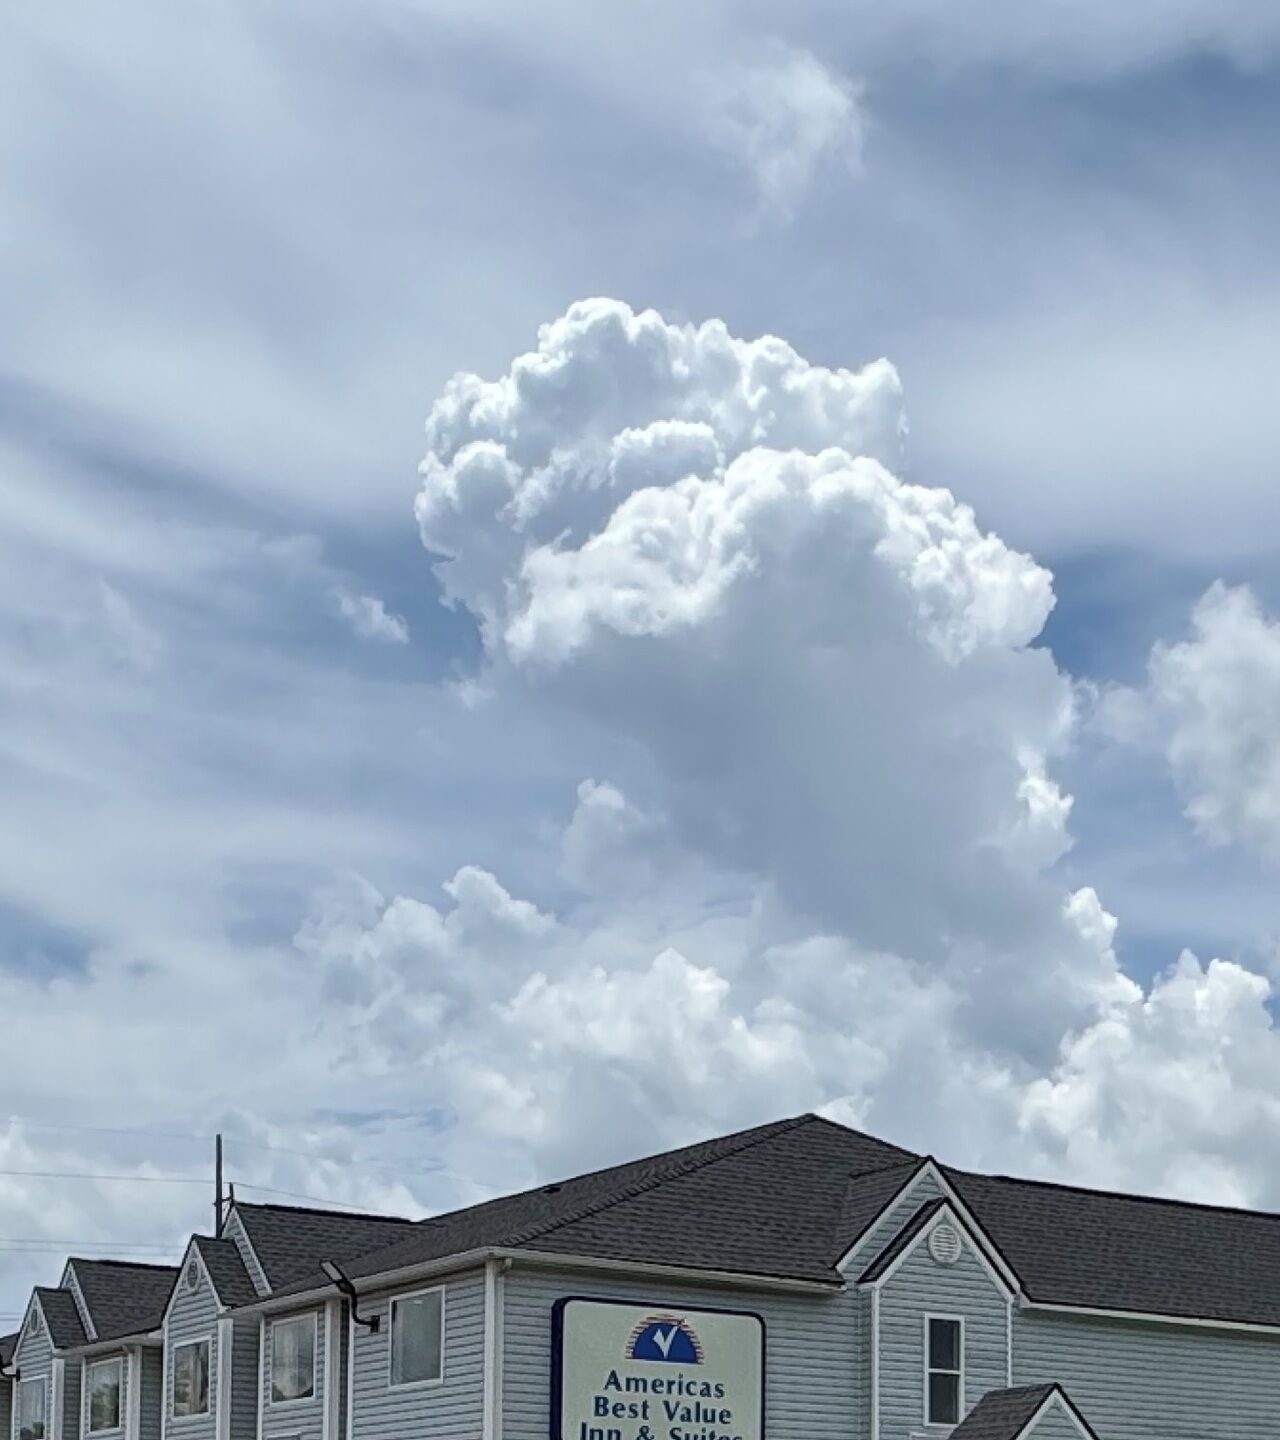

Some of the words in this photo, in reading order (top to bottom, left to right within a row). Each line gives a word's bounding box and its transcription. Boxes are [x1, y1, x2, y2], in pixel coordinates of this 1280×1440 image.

[603, 1369, 725, 1398] Americas
[593, 1396, 650, 1420] Best
[662, 1400, 732, 1424] Value
